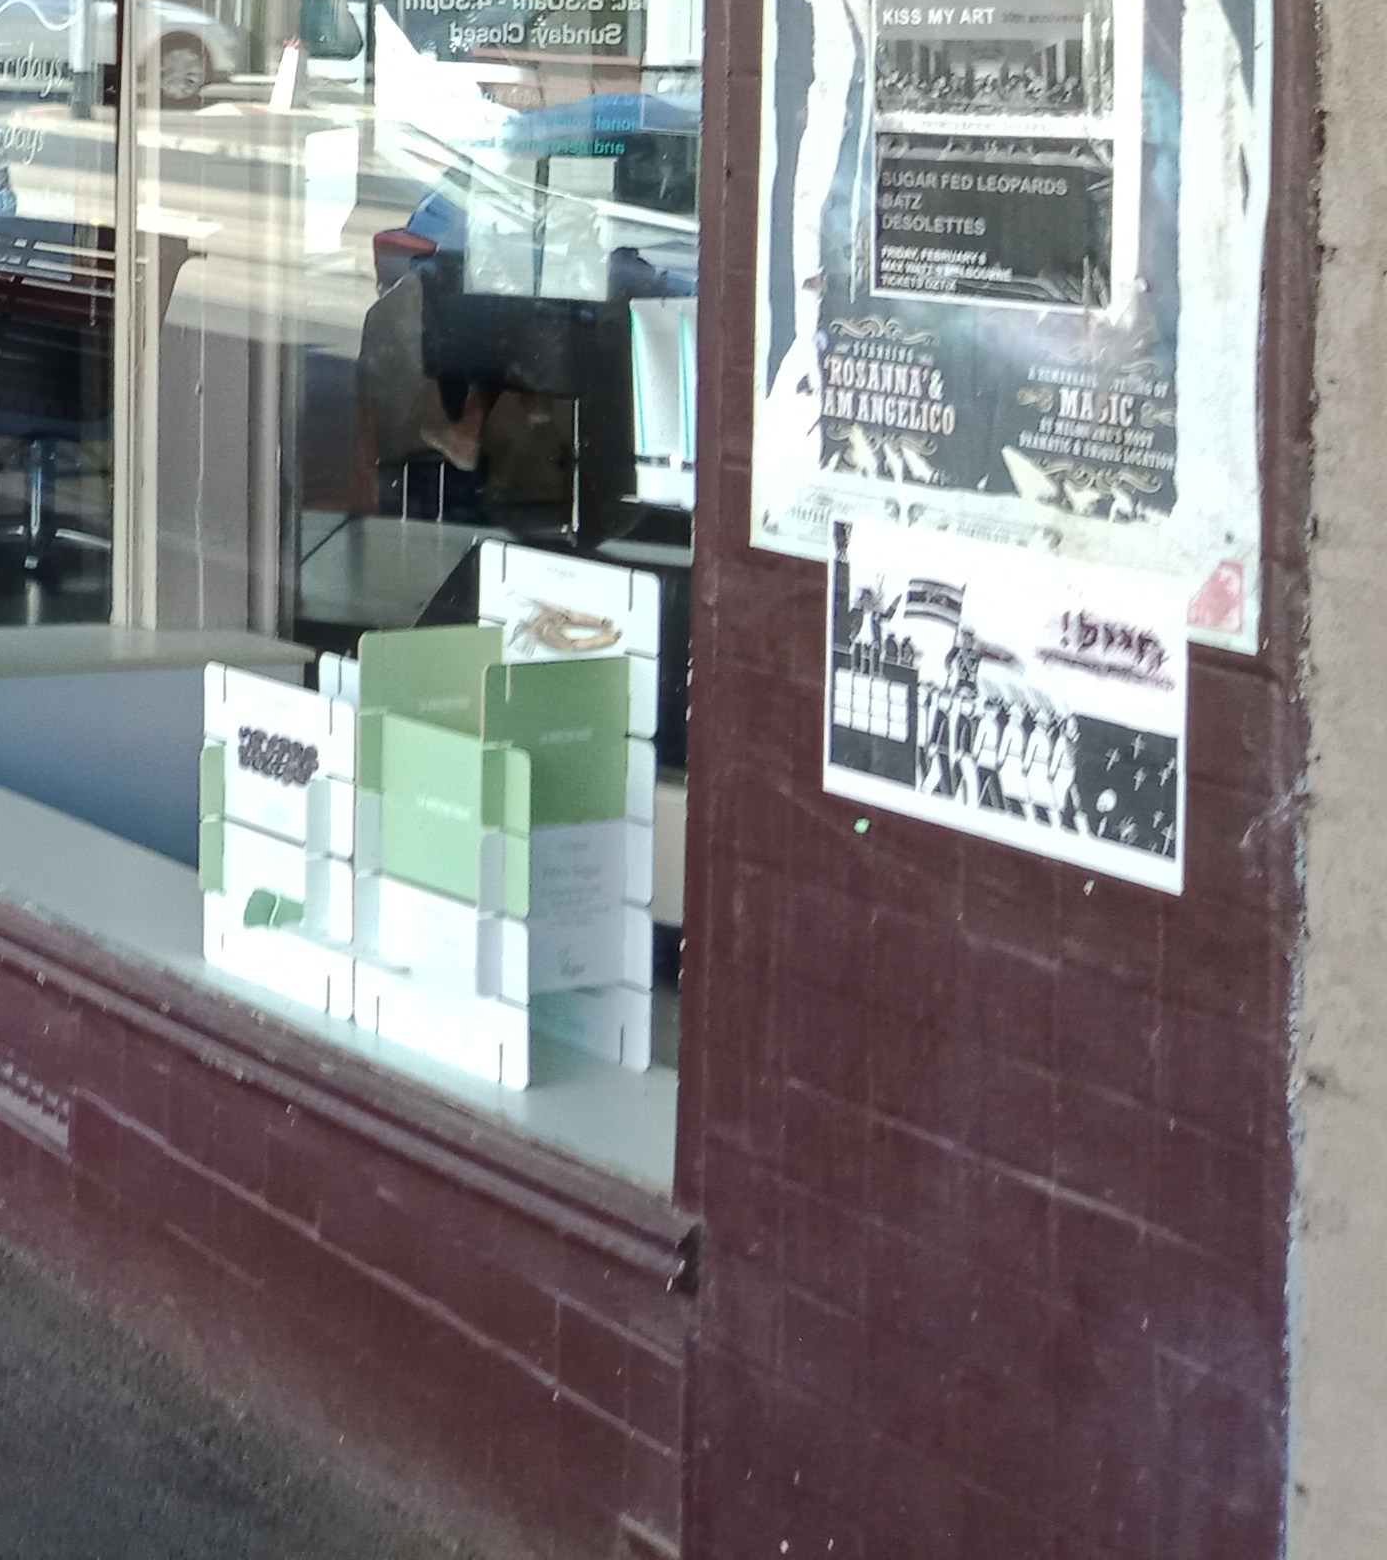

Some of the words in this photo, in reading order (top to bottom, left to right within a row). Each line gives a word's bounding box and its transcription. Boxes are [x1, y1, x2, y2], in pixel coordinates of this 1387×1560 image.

[882, 7, 923, 26] KISS
[927, 7, 956, 25] MY
[959, 6, 996, 25] ART
[881, 171, 939, 190] SUGAR
[940, 174, 974, 191] FED
[976, 175, 1069, 196] LEOPARDS
[856, 389, 956, 436] ANGELICO
